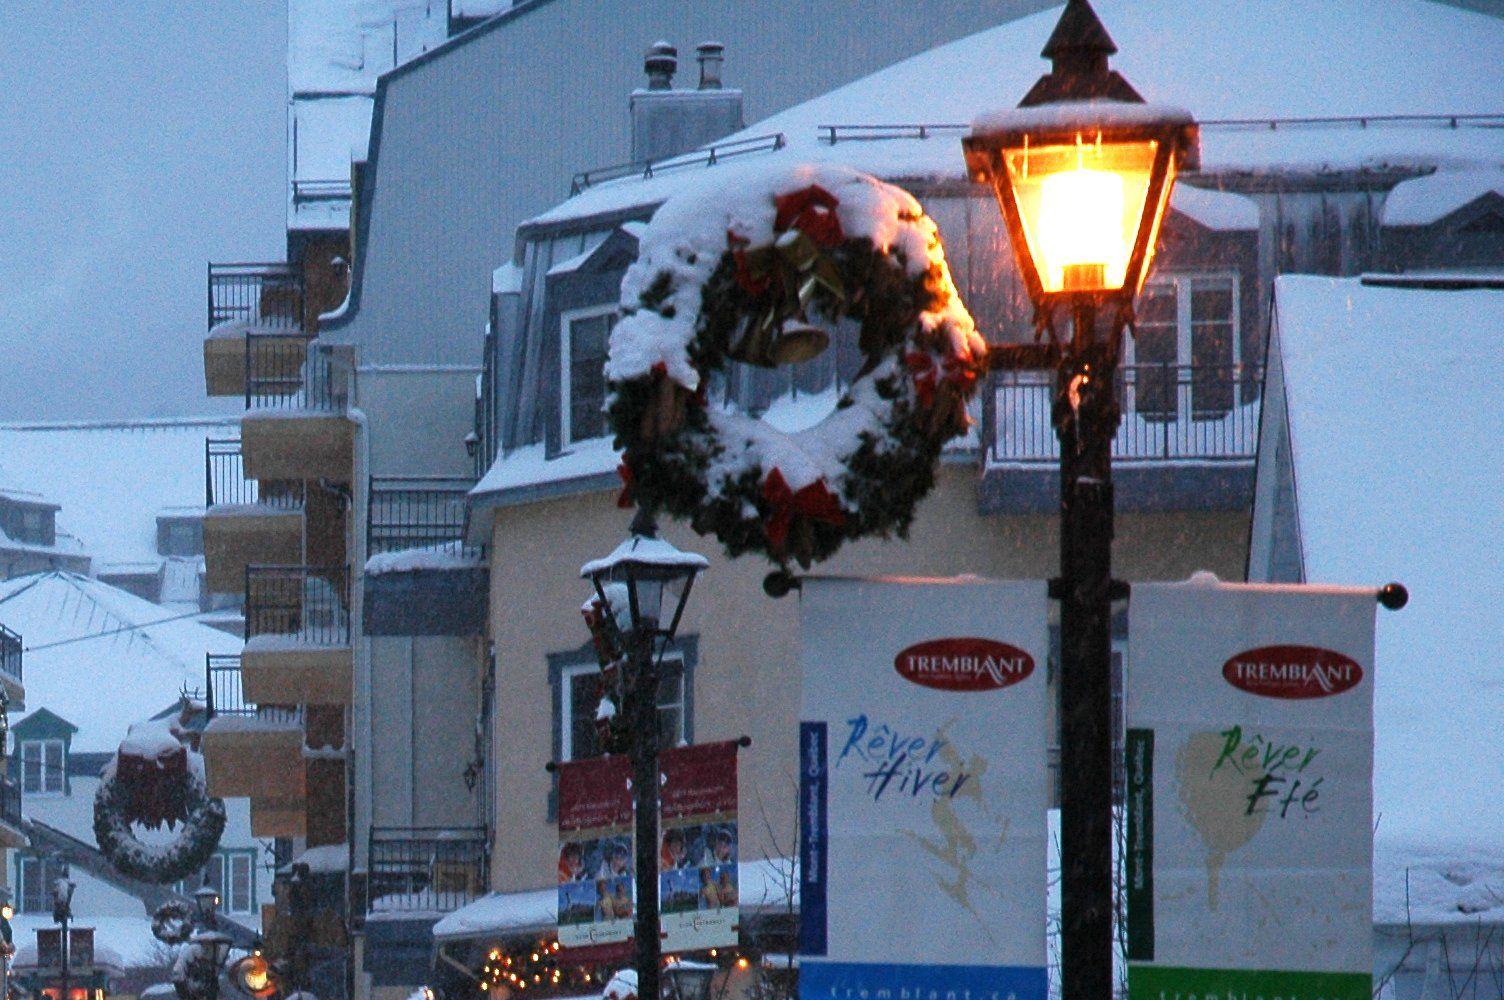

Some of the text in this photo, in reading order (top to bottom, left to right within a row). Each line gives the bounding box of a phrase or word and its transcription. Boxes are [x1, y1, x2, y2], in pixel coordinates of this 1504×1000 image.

[908, 654, 1025, 685] TREMBLANT
[1236, 660, 1353, 692] TREMBLANT
[864, 752, 971, 801] Hiver
